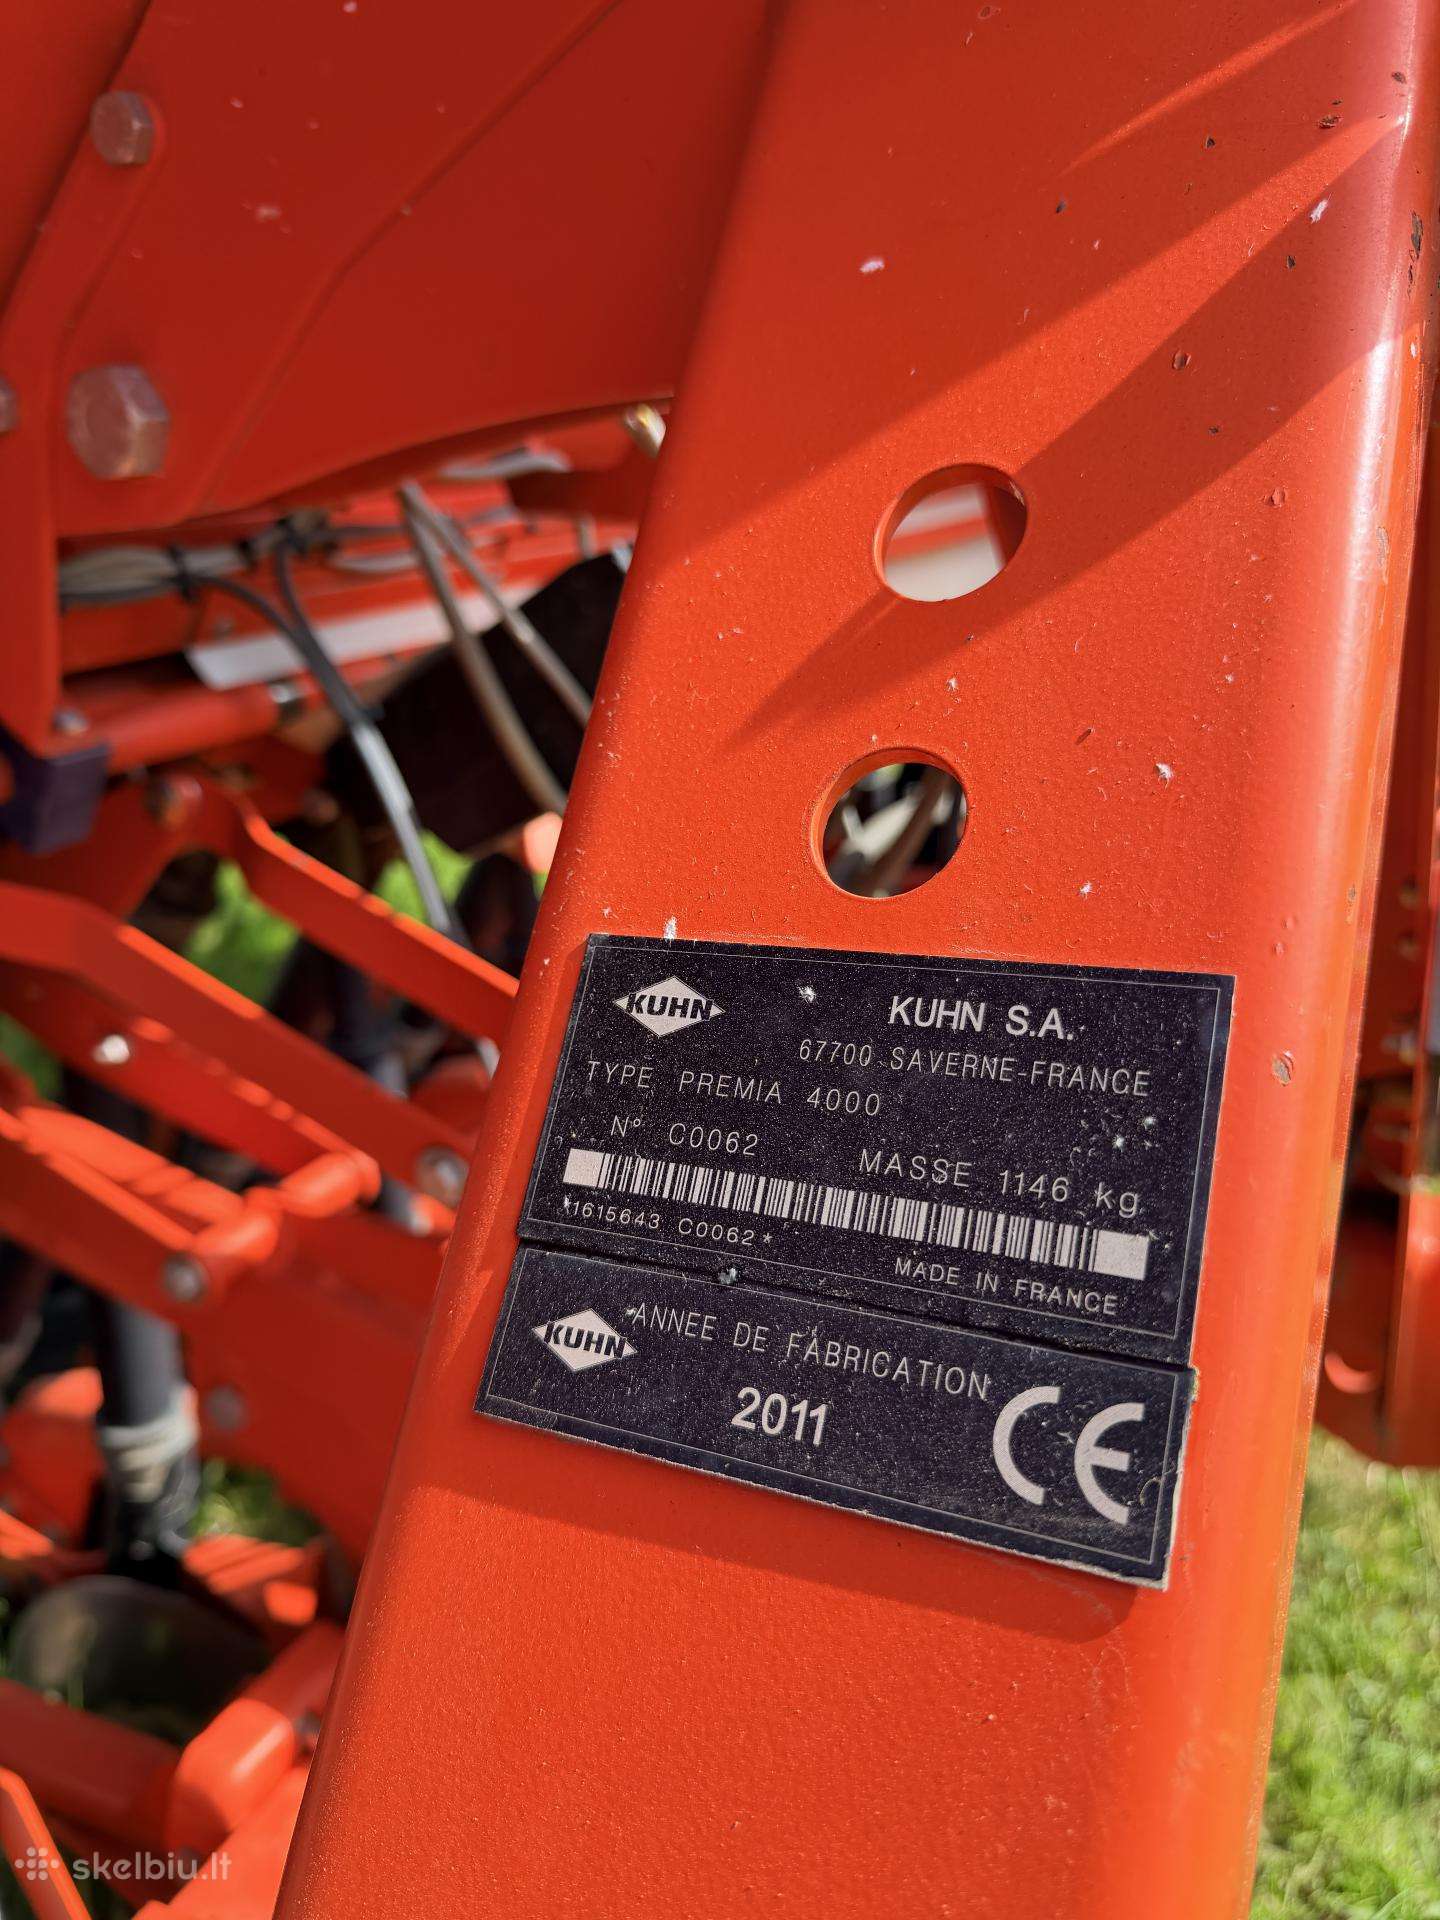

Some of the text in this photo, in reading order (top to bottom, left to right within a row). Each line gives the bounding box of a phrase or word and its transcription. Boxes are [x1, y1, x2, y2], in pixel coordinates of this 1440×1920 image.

[625, 992, 714, 1021] KUHN
[888, 996, 1075, 1040] KUHN S.A.
[587, 1060, 880, 1116] TYPE PREMIA 4000
[799, 1039, 1150, 1097] 67700 SAVERNE-FRANCE
[611, 1115, 759, 1156] N° C0062
[859, 1149, 1140, 1218] MASSE 1146 kg
[895, 1257, 1119, 1316] MADE IN FRANCE
[544, 1321, 626, 1359] KUHN
[632, 1302, 990, 1401] ANNEE DE FABRICATION
[731, 1386, 828, 1445] 2011
